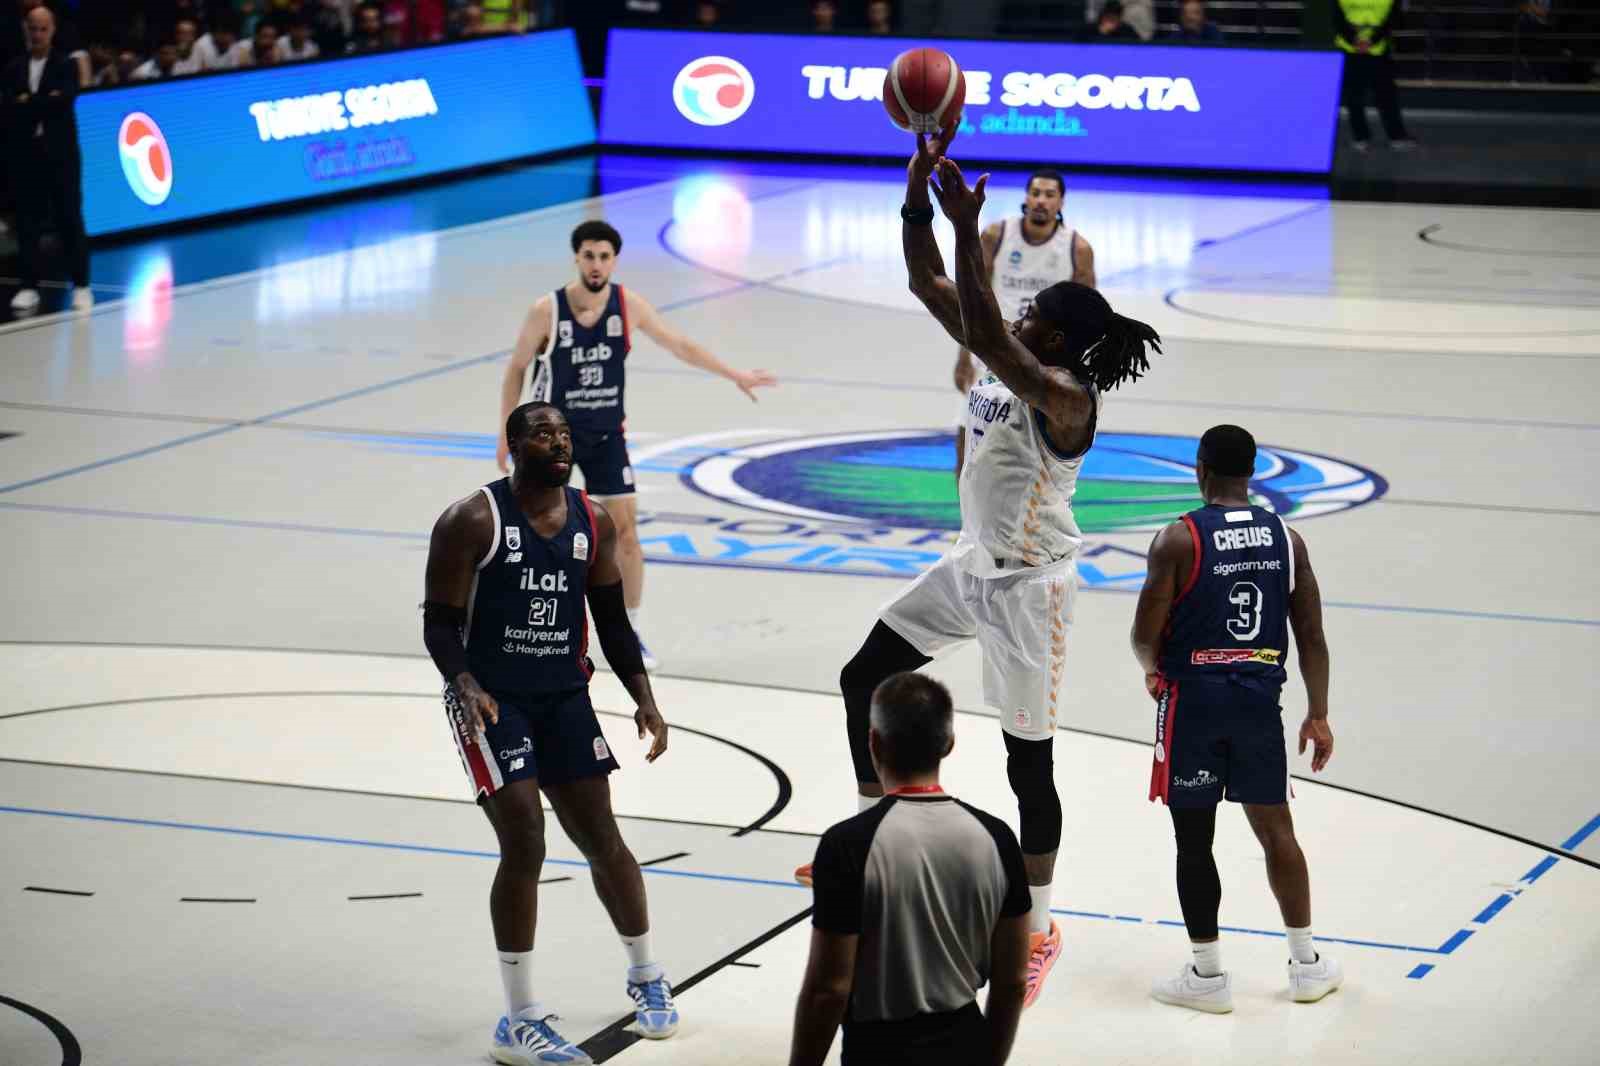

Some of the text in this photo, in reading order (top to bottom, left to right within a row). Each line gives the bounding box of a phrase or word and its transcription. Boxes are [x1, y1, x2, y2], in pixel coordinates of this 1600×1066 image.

[571, 341, 613, 365] iLab
[1213, 525, 1273, 552] CREWS
[1212, 559, 1281, 577] sigortam.net
[527, 597, 558, 627] 21
[1226, 581, 1264, 641] 3
